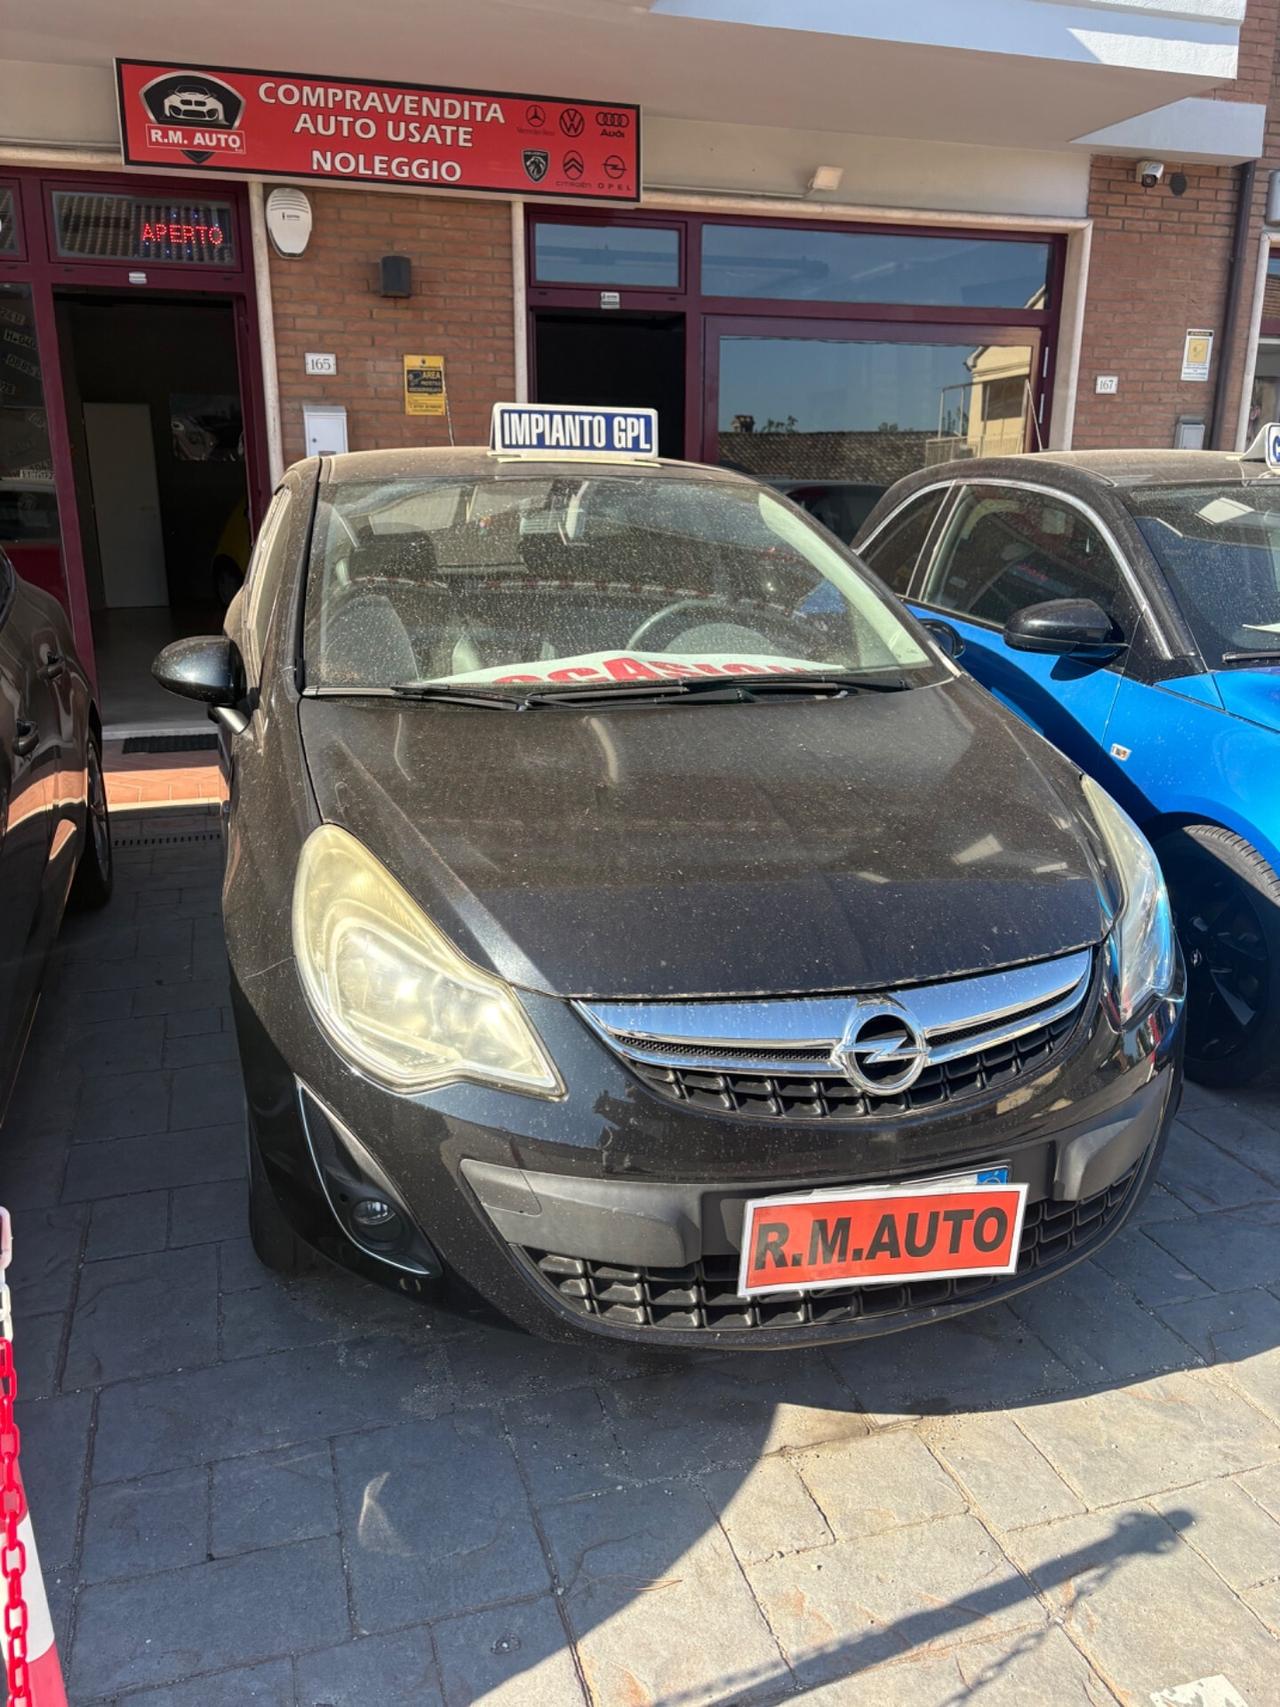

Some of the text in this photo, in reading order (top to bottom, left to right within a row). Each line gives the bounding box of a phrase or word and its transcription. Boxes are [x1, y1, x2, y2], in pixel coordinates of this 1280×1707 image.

[258, 82, 505, 124] COMPRAVENDITA
[150, 128, 241, 148] R.M. AUTO
[293, 113, 474, 147] AUTO USATE
[311, 150, 462, 182] NOLEGGIO
[142, 223, 223, 245] APERTO
[311, 358, 331, 371] 165
[1100, 379, 1114, 390] 167
[503, 412, 651, 450] IMPIANTO GPL
[754, 1206, 1009, 1271] R.M.AUTO
